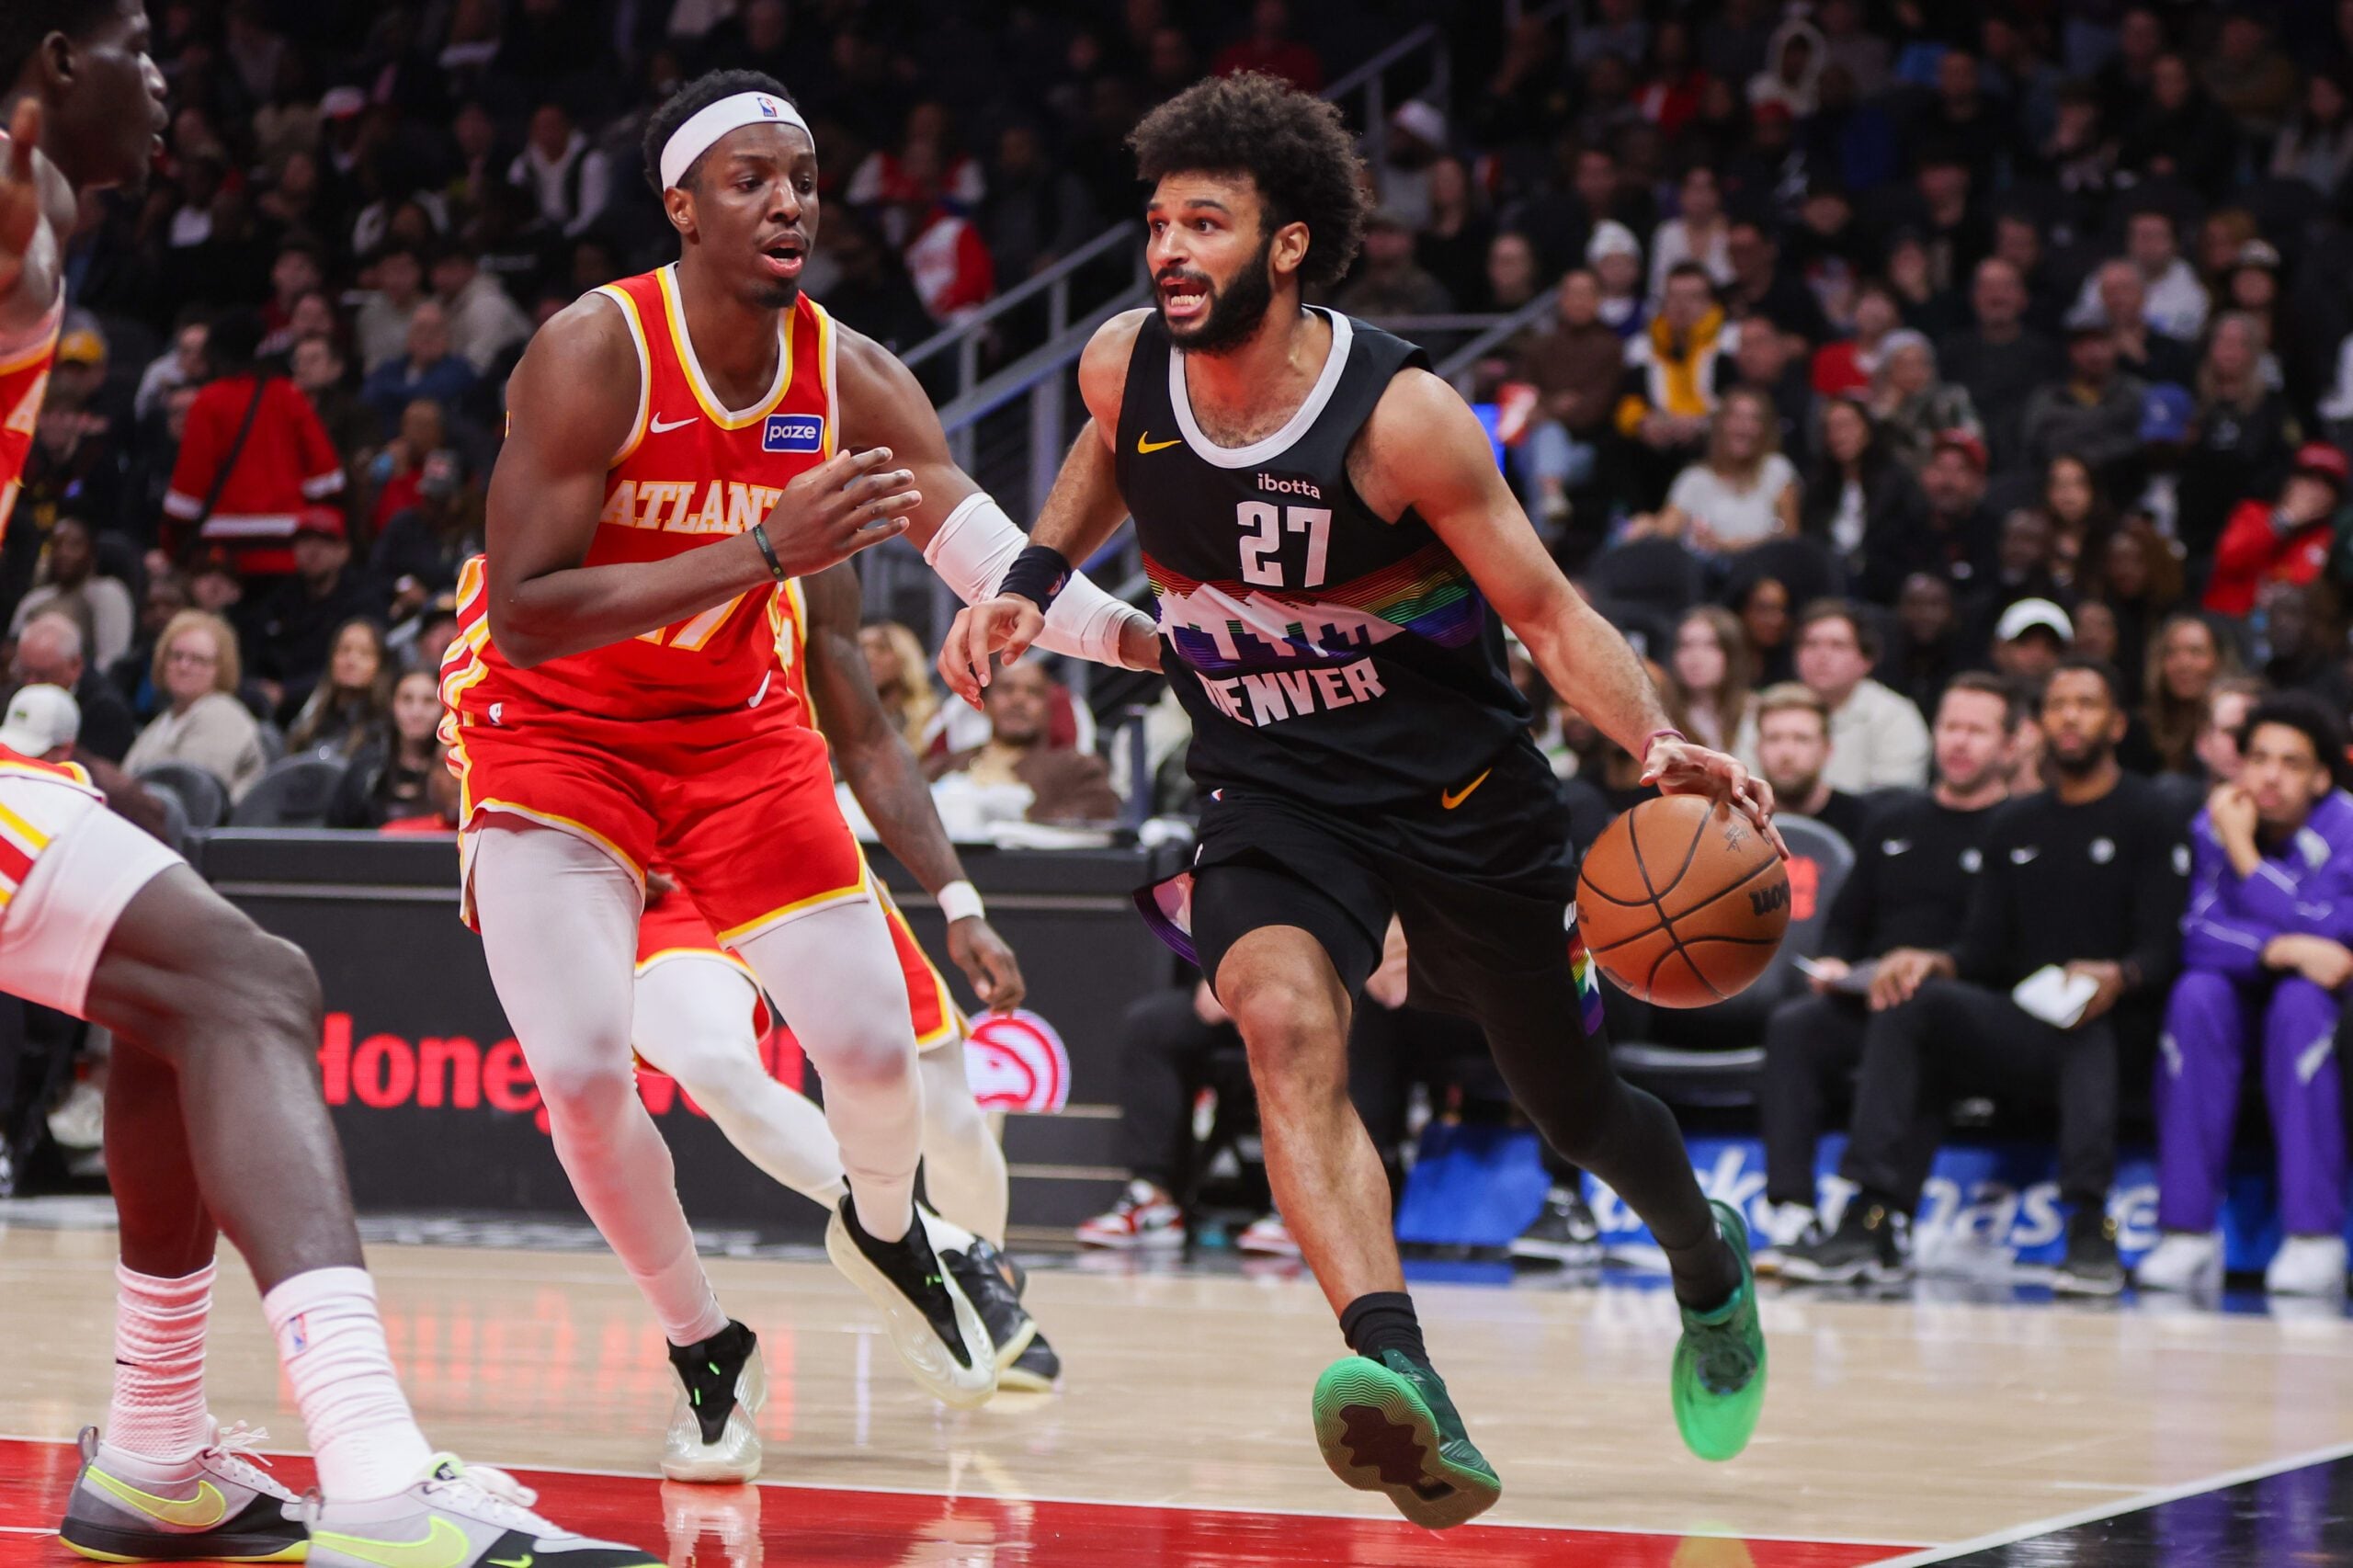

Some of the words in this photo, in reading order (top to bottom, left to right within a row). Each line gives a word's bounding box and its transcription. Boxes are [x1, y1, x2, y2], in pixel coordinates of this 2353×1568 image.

[768, 424, 817, 442] paze
[599, 479, 784, 536] ATLAN
[1256, 472, 1321, 500] ibotta
[1236, 500, 1333, 588] 27
[1194, 656, 1386, 728] DENVER
